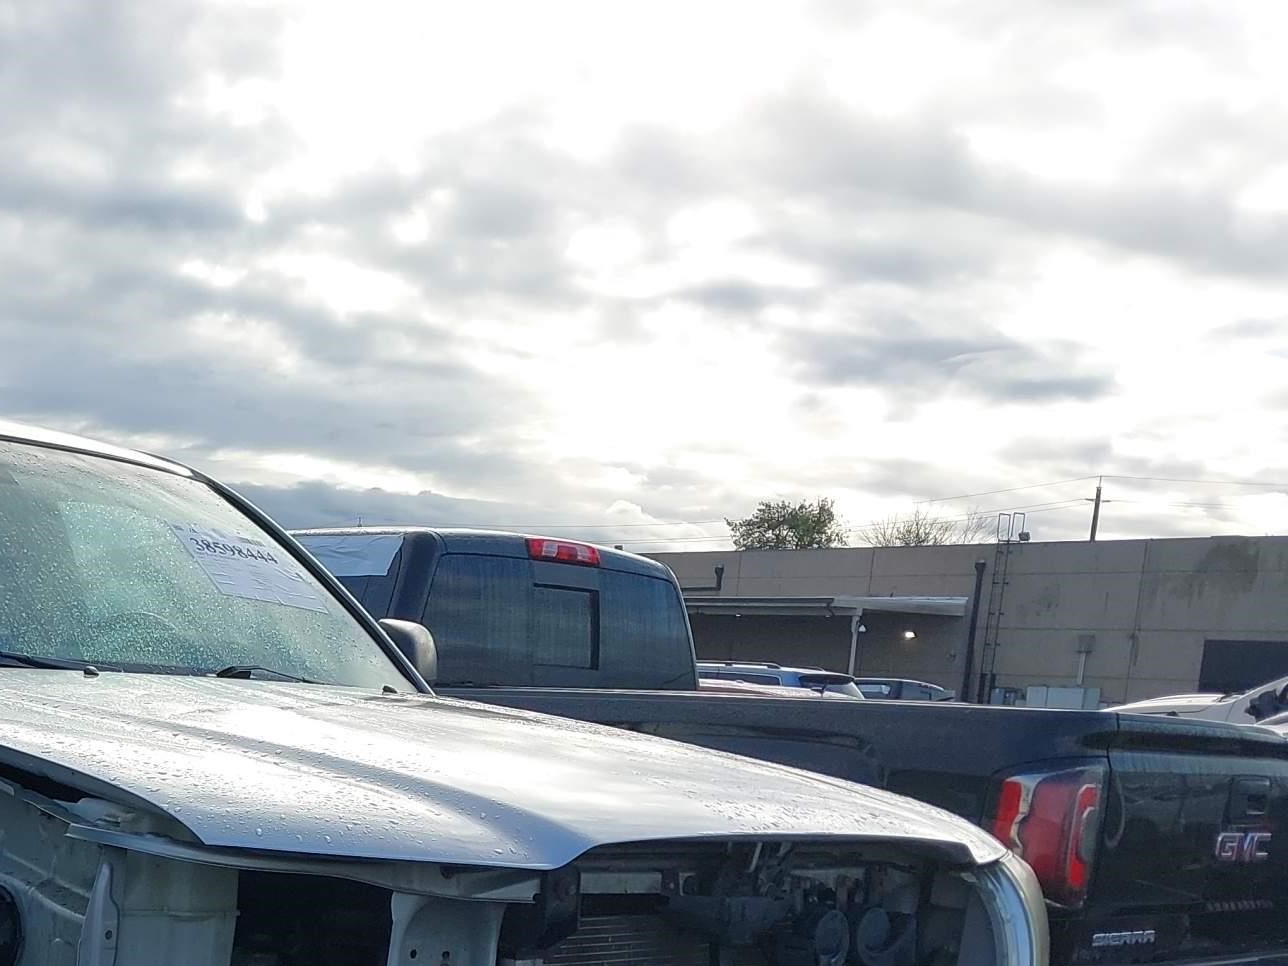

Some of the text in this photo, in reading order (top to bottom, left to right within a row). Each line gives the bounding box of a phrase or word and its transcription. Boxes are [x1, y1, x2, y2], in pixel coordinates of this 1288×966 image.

[190, 537, 279, 564] 38598444
[1215, 832, 1272, 863] GMC
[1092, 930, 1155, 946] SIERRA
